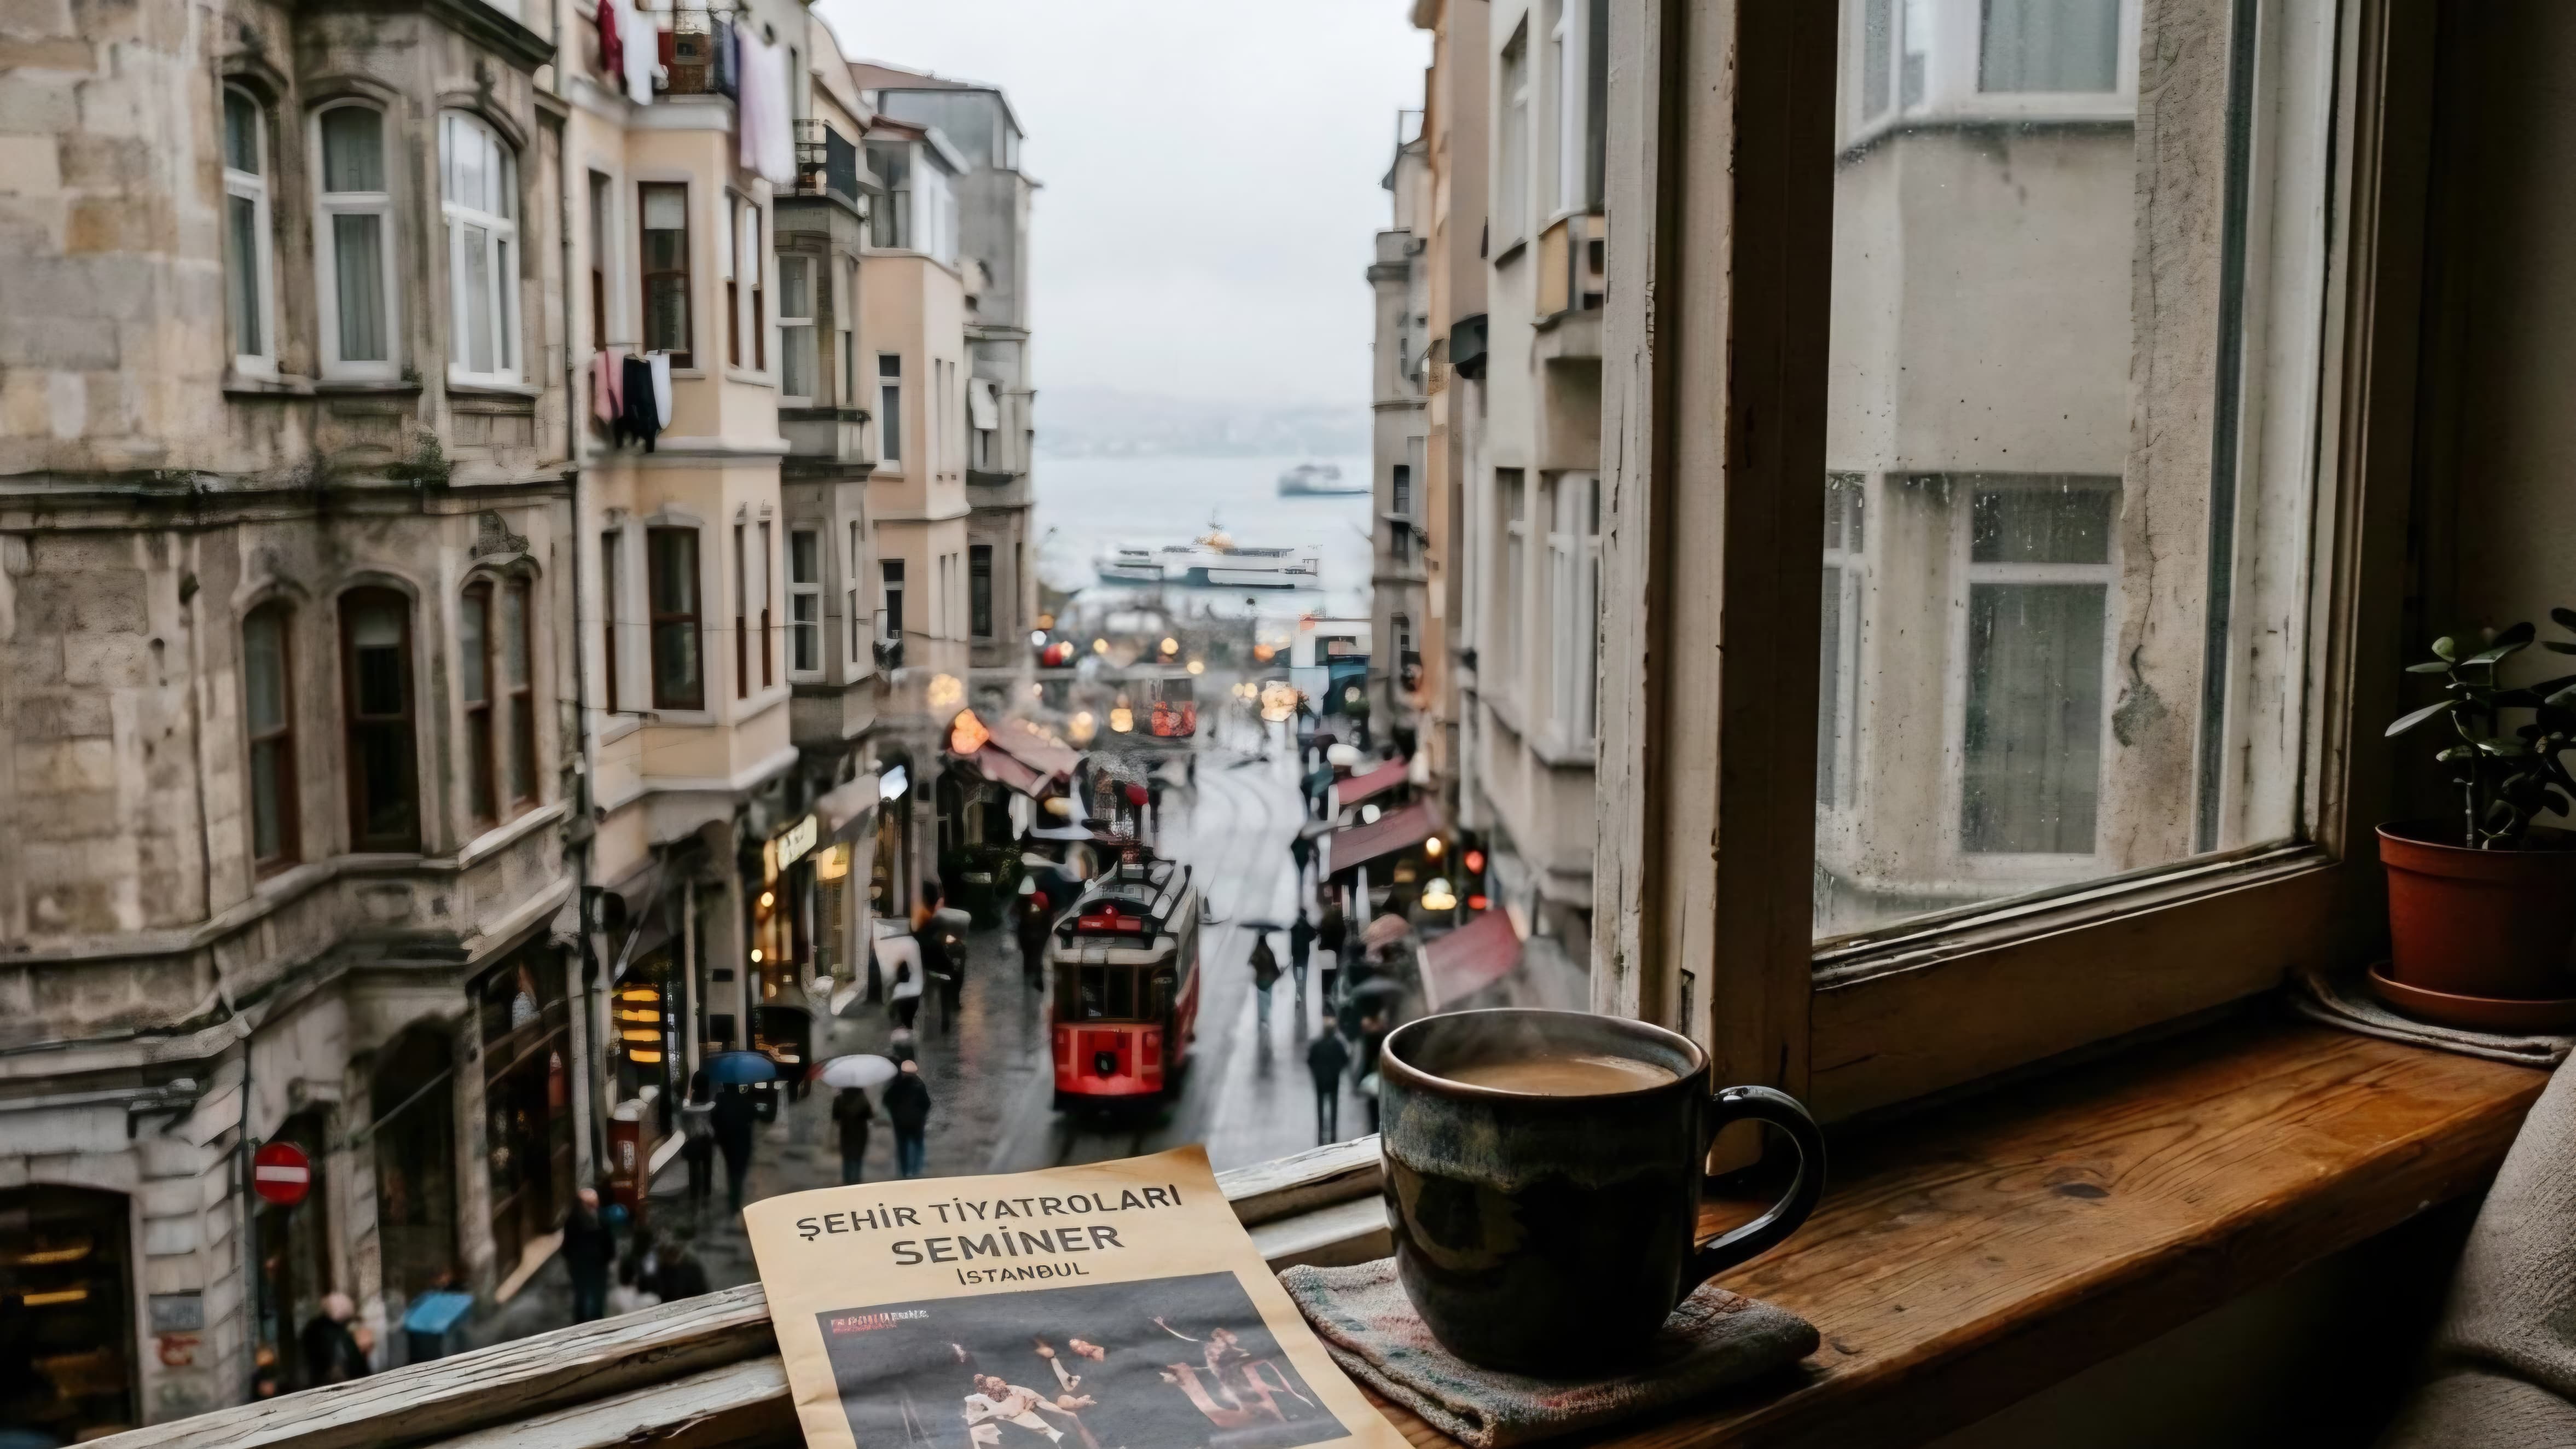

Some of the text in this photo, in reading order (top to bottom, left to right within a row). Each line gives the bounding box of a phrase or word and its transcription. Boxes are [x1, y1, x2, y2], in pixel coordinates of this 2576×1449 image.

[796, 1184, 1182, 1242] ŞEHİR TİYATROLARI
[891, 1226, 1125, 1266] SEMİNER
